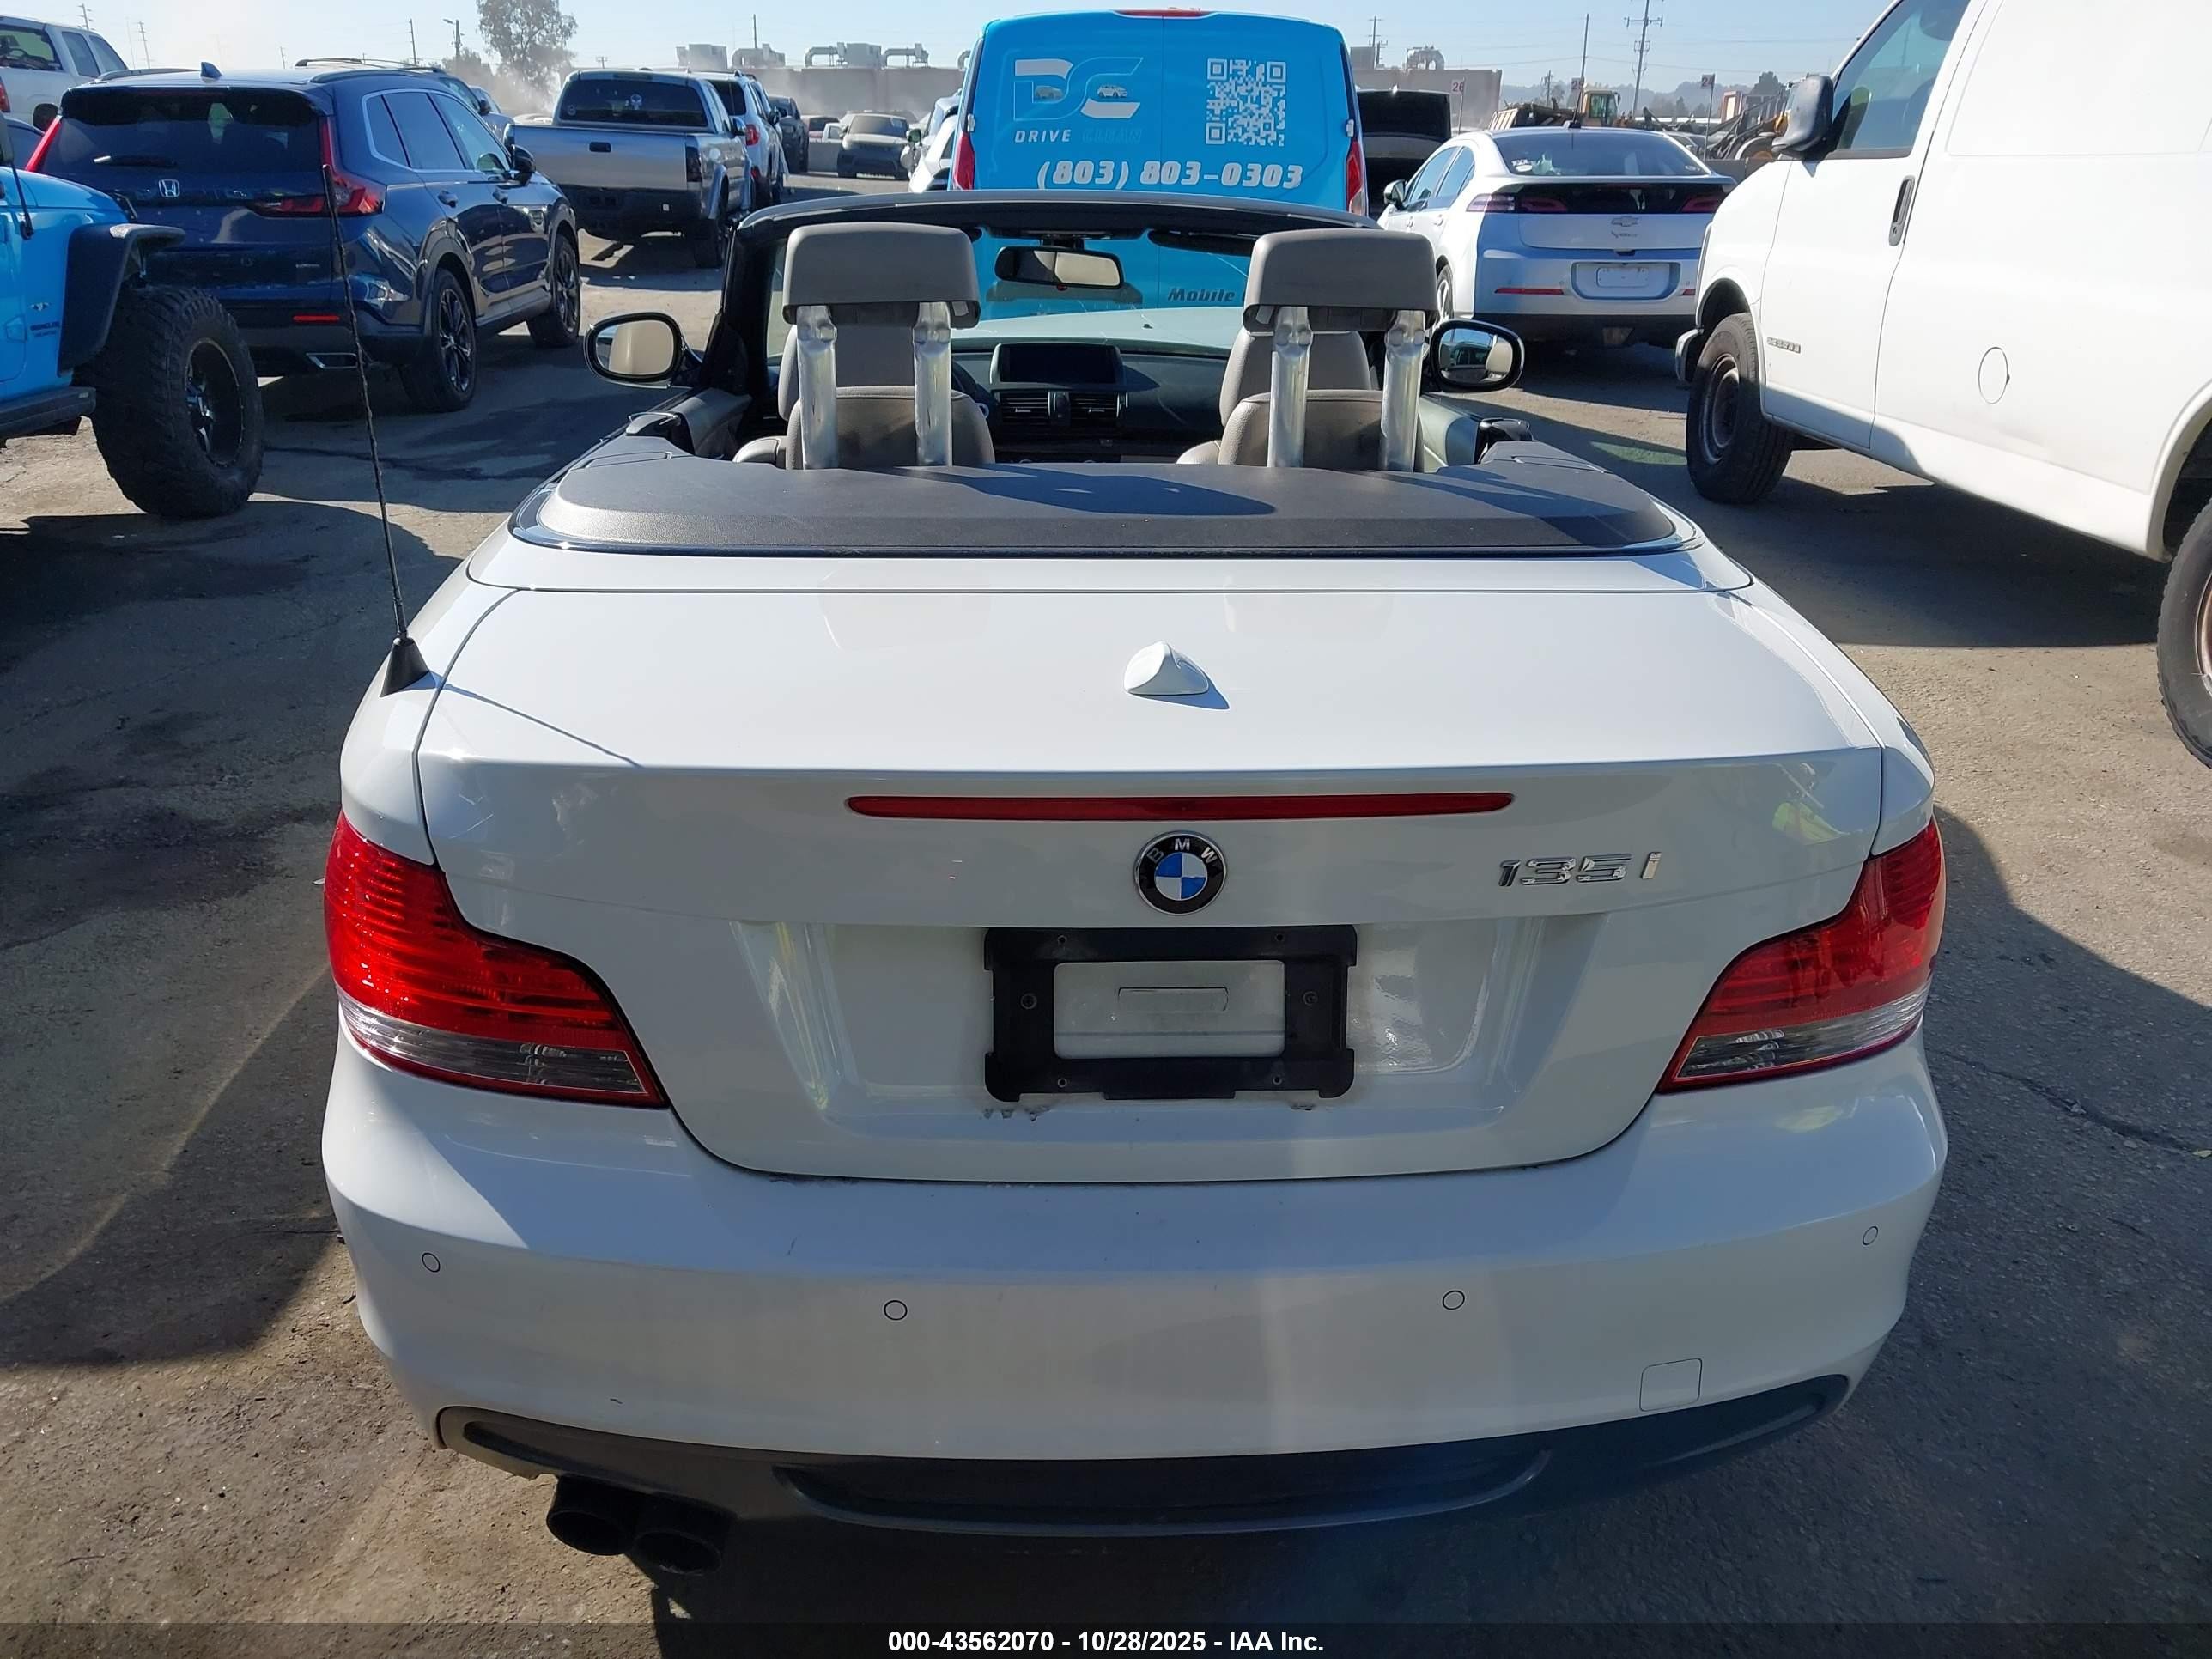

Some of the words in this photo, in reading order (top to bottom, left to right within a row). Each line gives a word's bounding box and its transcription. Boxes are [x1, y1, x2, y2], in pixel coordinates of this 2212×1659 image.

[1014, 130, 1072, 143] DRIVE
[1037, 161, 1129, 190] (803)
[1139, 161, 1304, 189] 803-0303
[1167, 288, 1236, 302] Mobile
[1146, 837, 1218, 863] BMW
[1498, 851, 1662, 887] 135i
